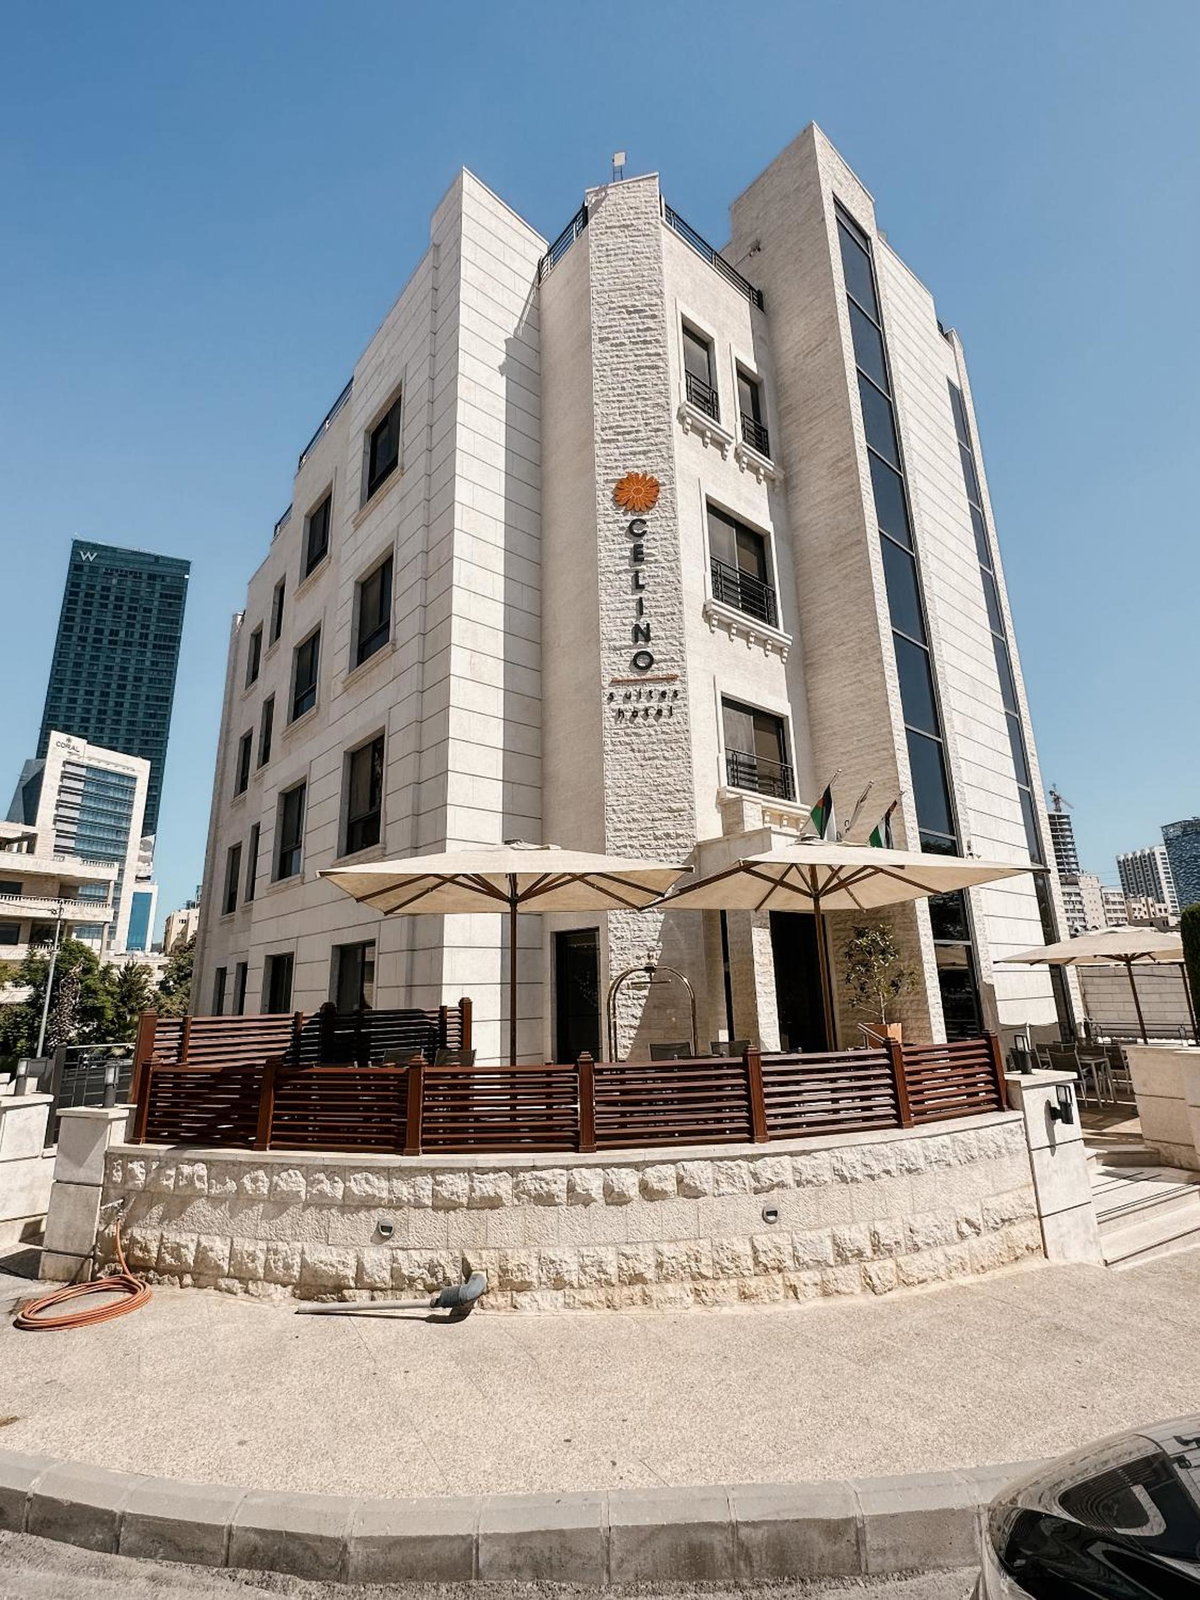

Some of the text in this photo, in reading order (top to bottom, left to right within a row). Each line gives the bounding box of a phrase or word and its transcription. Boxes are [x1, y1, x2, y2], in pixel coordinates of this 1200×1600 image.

[80, 551, 97, 561] W
[628, 518, 654, 671] CELINO
[607, 688, 678, 700] suites
[617, 706, 673, 719] hotel
[56, 741, 80, 752] CORAL
